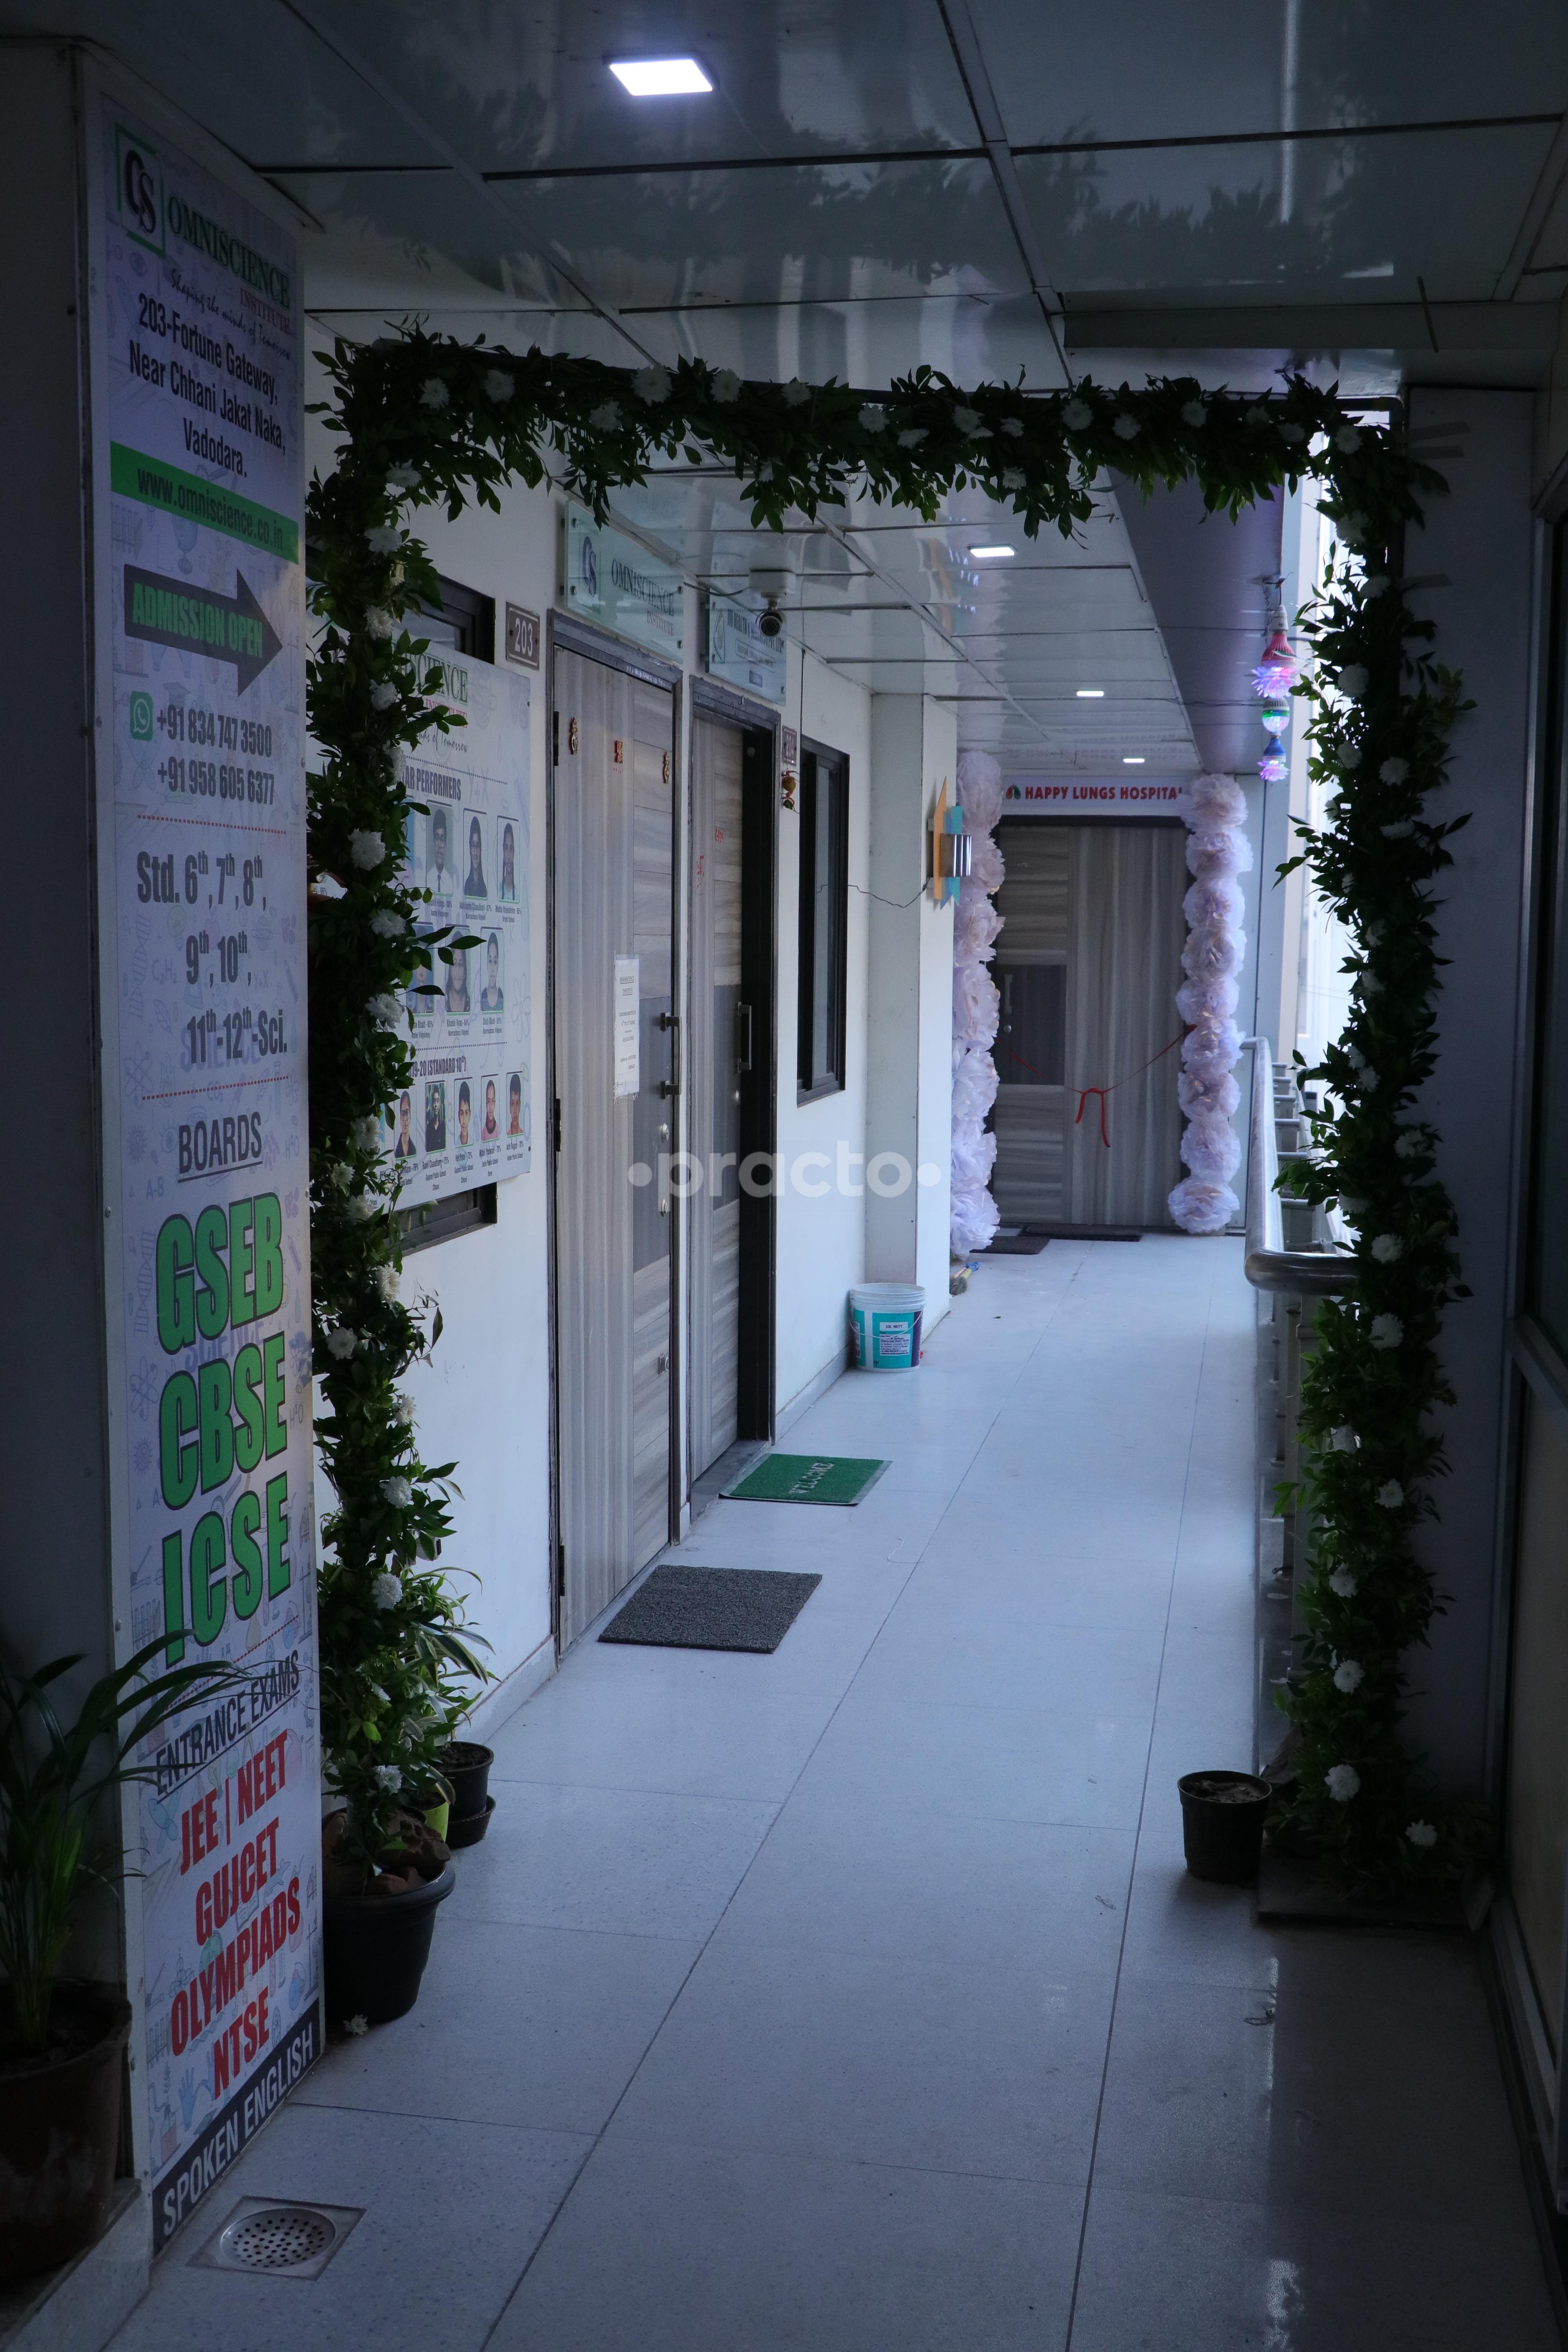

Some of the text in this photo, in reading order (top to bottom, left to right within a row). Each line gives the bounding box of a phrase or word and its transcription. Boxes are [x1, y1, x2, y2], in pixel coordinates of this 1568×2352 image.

[168, 196, 290, 310] OMNISCIENCE
[139, 293, 278, 406] 203-Fortune Gateway,
[172, 269, 290, 361] Shaping the minds of Tomorrow
[240, 287, 290, 335] INSTITUTE
[129, 339, 286, 455] Near Chhani Jakat Naka,
[183, 417, 247, 477] Vadodara.
[138, 468, 283, 550] www.omniscience.co.in
[133, 582, 263, 659] ADMISSION OPEN
[611, 559, 675, 617] OMNISCIENCE
[647, 610, 674, 636] INSTITUTE
[515, 617, 533, 657] 203
[157, 705, 272, 757] +91 834 747 3500
[786, 735, 795, 758] 204
[158, 757, 274, 806] +91 958 605 6377
[402, 765, 461, 801] AR PERFORMERS
[1025, 786, 1069, 799] HAPPY
[1073, 786, 1115, 799] LUNGS
[136, 850, 180, 904] Std.
[408, 1060, 426, 1078] 19-20
[179, 1111, 262, 1174] BOARDS
[157, 1192, 284, 1356] GSEB
[158, 1330, 289, 1512] CBSE
[789, 1462, 835, 1494] WELCOME
[162, 1470, 291, 1670] ICSE
[157, 1650, 300, 1796] ENTRANCE EXAMS
[180, 1728, 288, 1876] JEE NEET
[196, 1815, 279, 1947] GUJCET
[171, 1876, 301, 2057] OLYMPIADS
[213, 1985, 270, 2101] NTSE
[163, 2021, 313, 2238] SPOKEN ENGLISH
